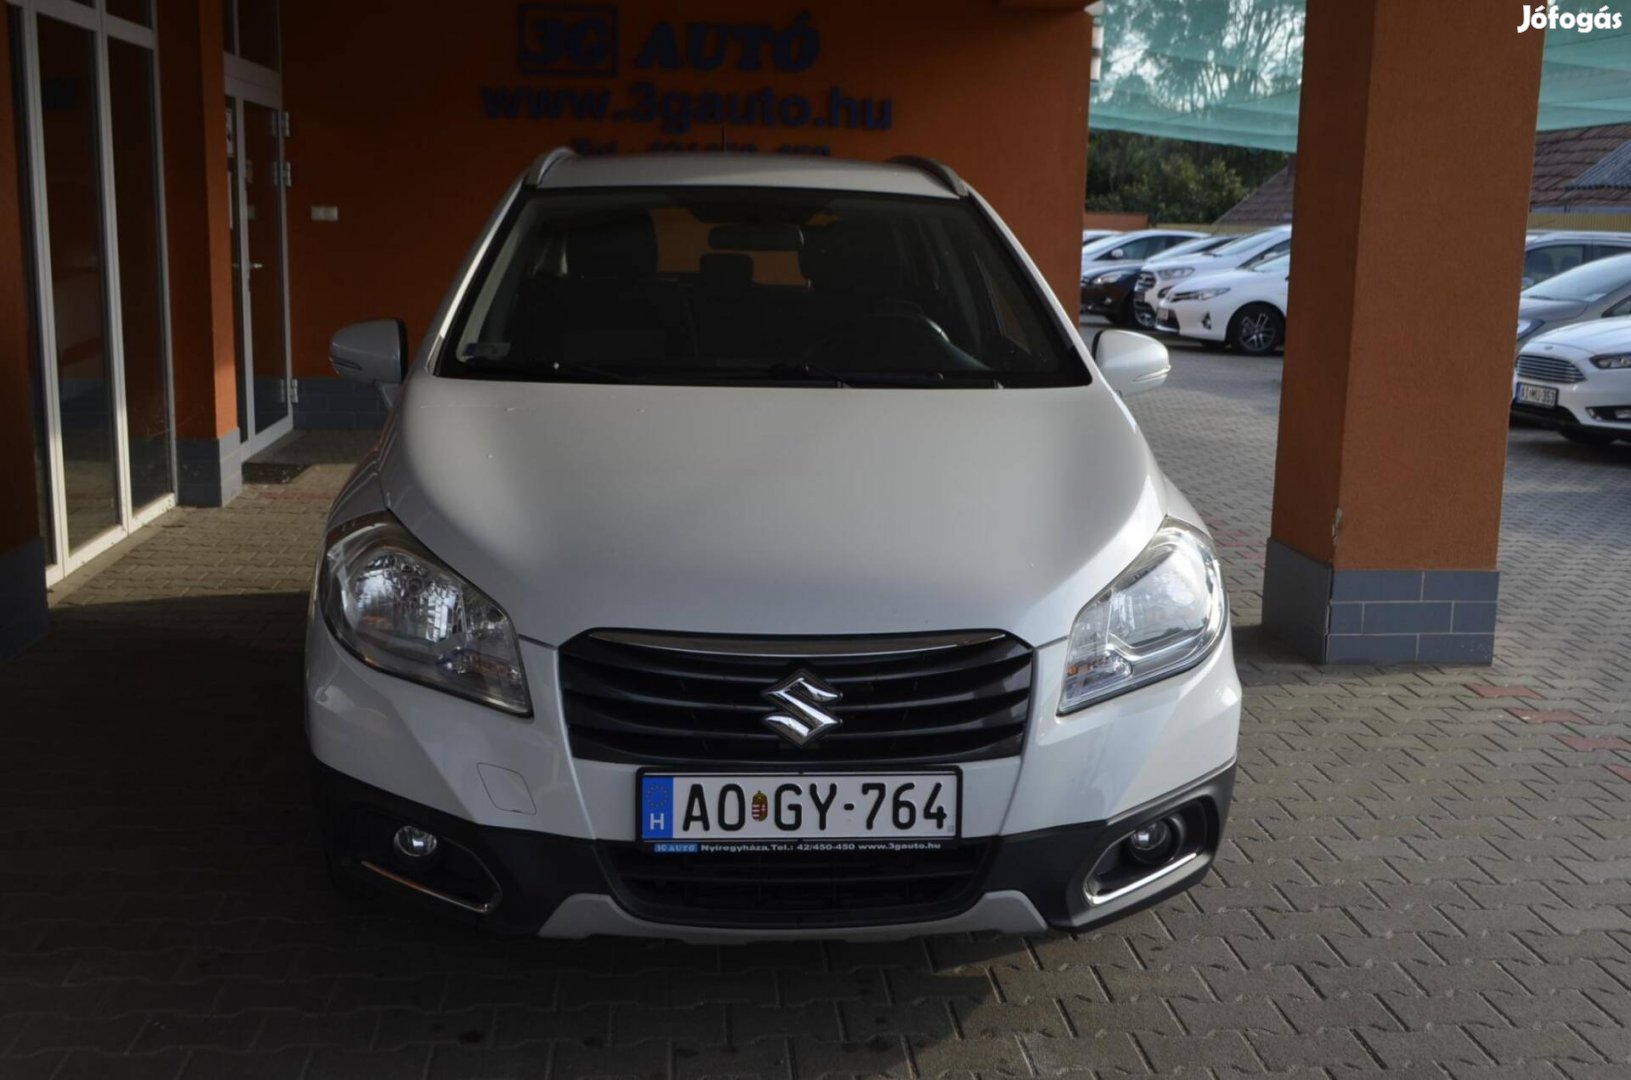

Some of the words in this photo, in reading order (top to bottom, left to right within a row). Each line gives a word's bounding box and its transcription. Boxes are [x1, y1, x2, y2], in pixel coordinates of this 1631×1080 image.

[523, 18, 613, 68] 3G
[635, 11, 819, 71] AUTÓ
[483, 82, 892, 133] www.3gauto.hu
[649, 812, 665, 831] H
[682, 783, 746, 832] AO
[774, 782, 948, 831] GY-764
[797, 843, 855, 851] 42/450-450
[858, 842, 941, 851] www.3gauto.hu
